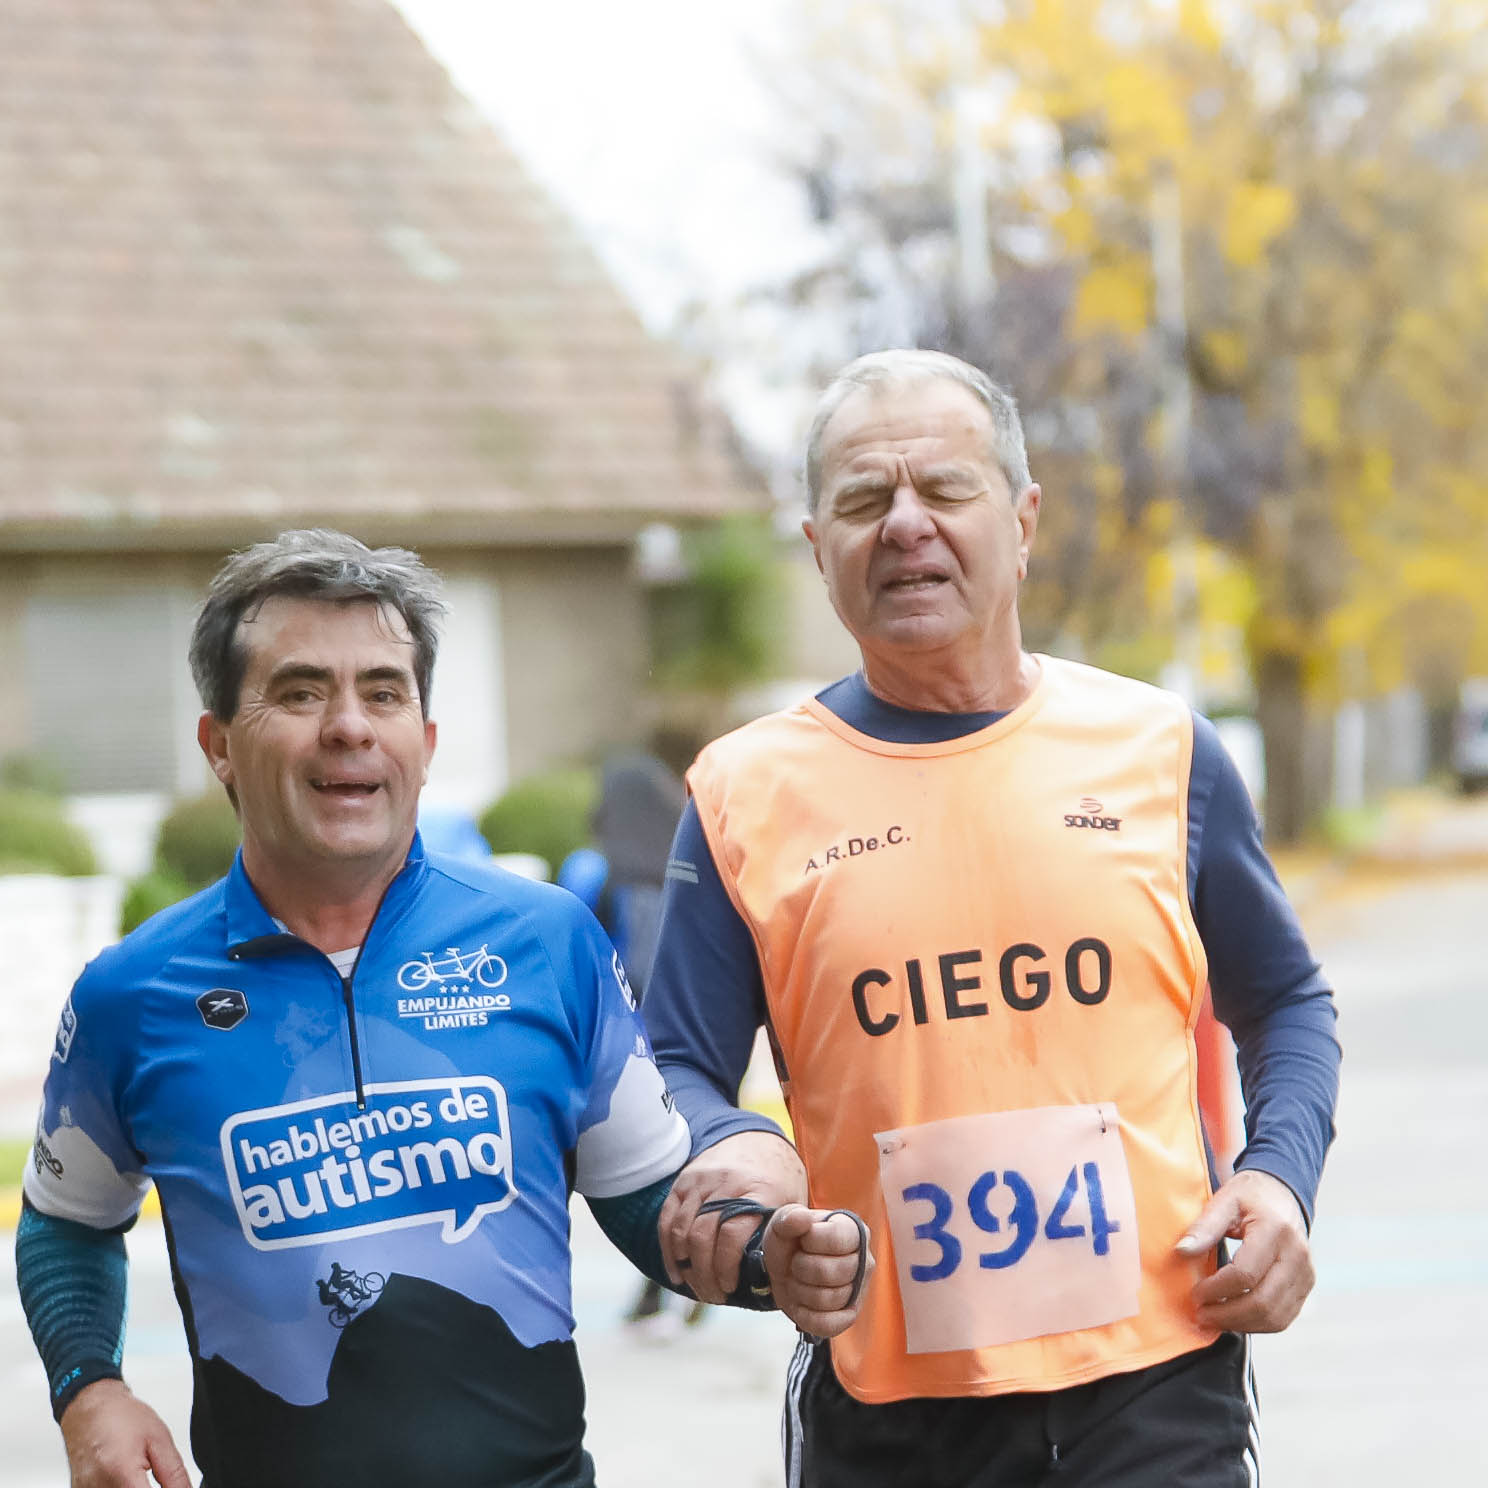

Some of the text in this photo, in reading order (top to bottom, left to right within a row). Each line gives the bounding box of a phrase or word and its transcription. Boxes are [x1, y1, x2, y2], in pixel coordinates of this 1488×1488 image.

[397, 994, 511, 1013] EMPUJANDO
[424, 1011, 489, 1030] LIMITES
[851, 937, 1113, 1037] CIEGO
[240, 1087, 489, 1174] hablemos de
[242, 1132, 506, 1228] autismo
[901, 1161, 1120, 1283] 394
